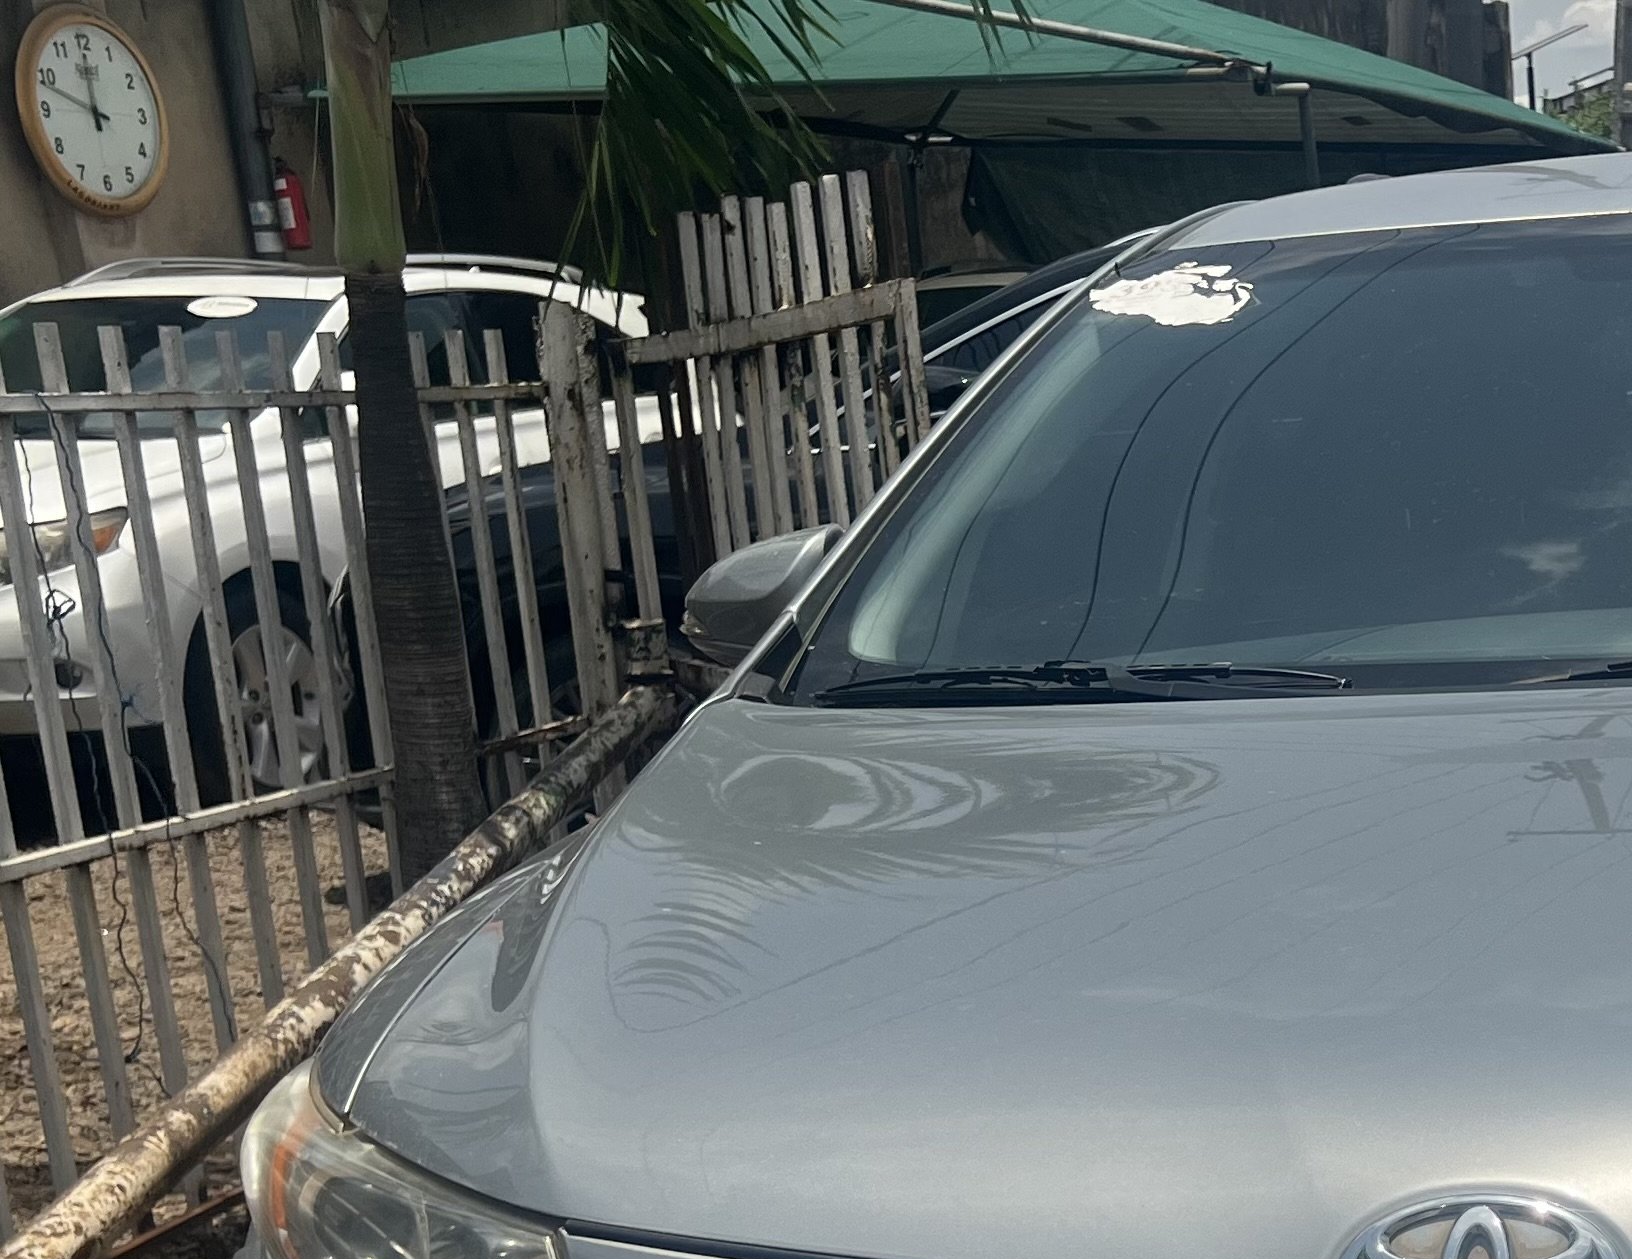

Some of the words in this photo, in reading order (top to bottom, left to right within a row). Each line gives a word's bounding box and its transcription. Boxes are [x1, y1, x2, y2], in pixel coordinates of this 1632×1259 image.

[53, 42, 68, 58] 11
[74, 32, 91, 51] 12
[105, 46, 113, 62] 1
[38, 68, 56, 86] 10
[125, 73, 135, 90] 2
[41, 101, 51, 118] 9
[137, 108, 147, 125] 3
[54, 137, 64, 154] 8
[138, 142, 147, 158] 4
[76, 165, 85, 180] 7
[124, 166, 134, 183] 5
[103, 174, 112, 191] 6
